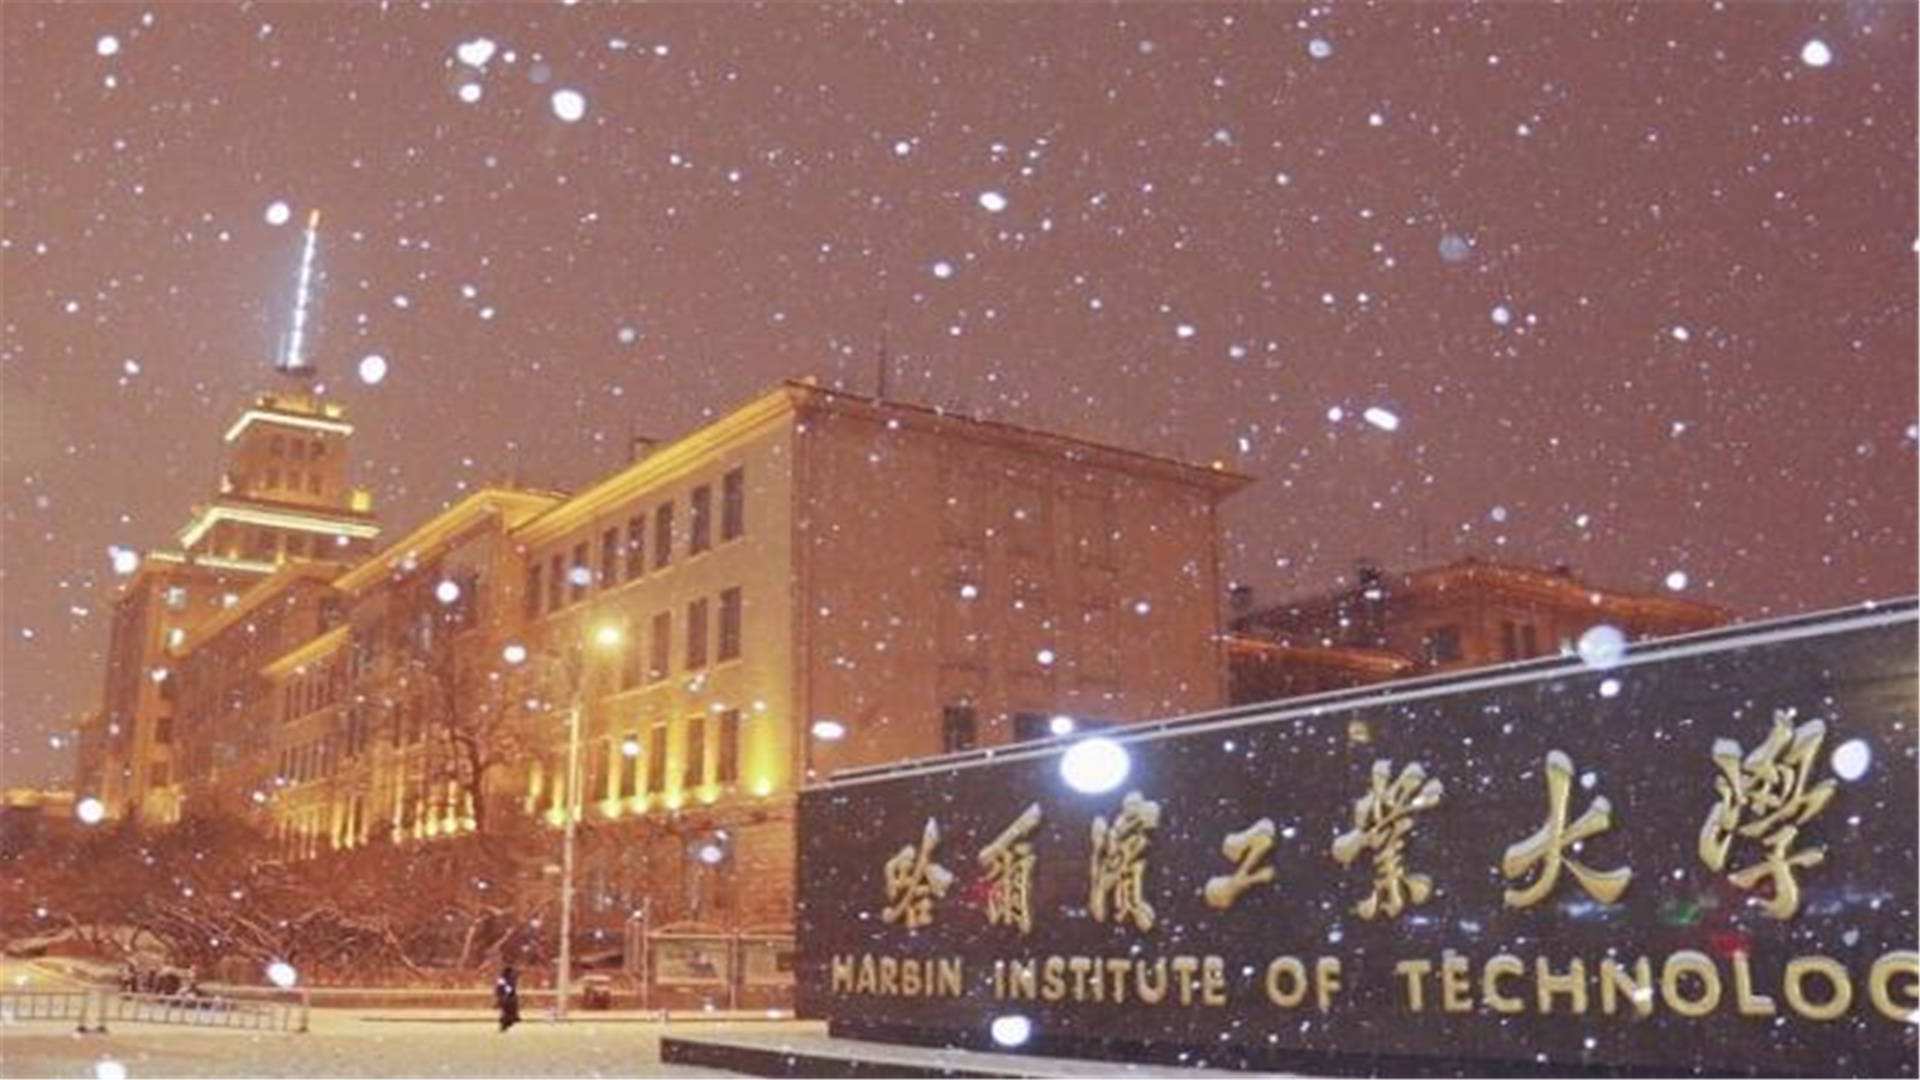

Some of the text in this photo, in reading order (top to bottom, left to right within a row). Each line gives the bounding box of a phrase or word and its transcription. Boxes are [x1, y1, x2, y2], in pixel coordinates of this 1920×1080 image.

[831, 955, 963, 997] HARBIN
[995, 955, 1227, 1005] INSTITUTE
[1265, 955, 1342, 1011] OF
